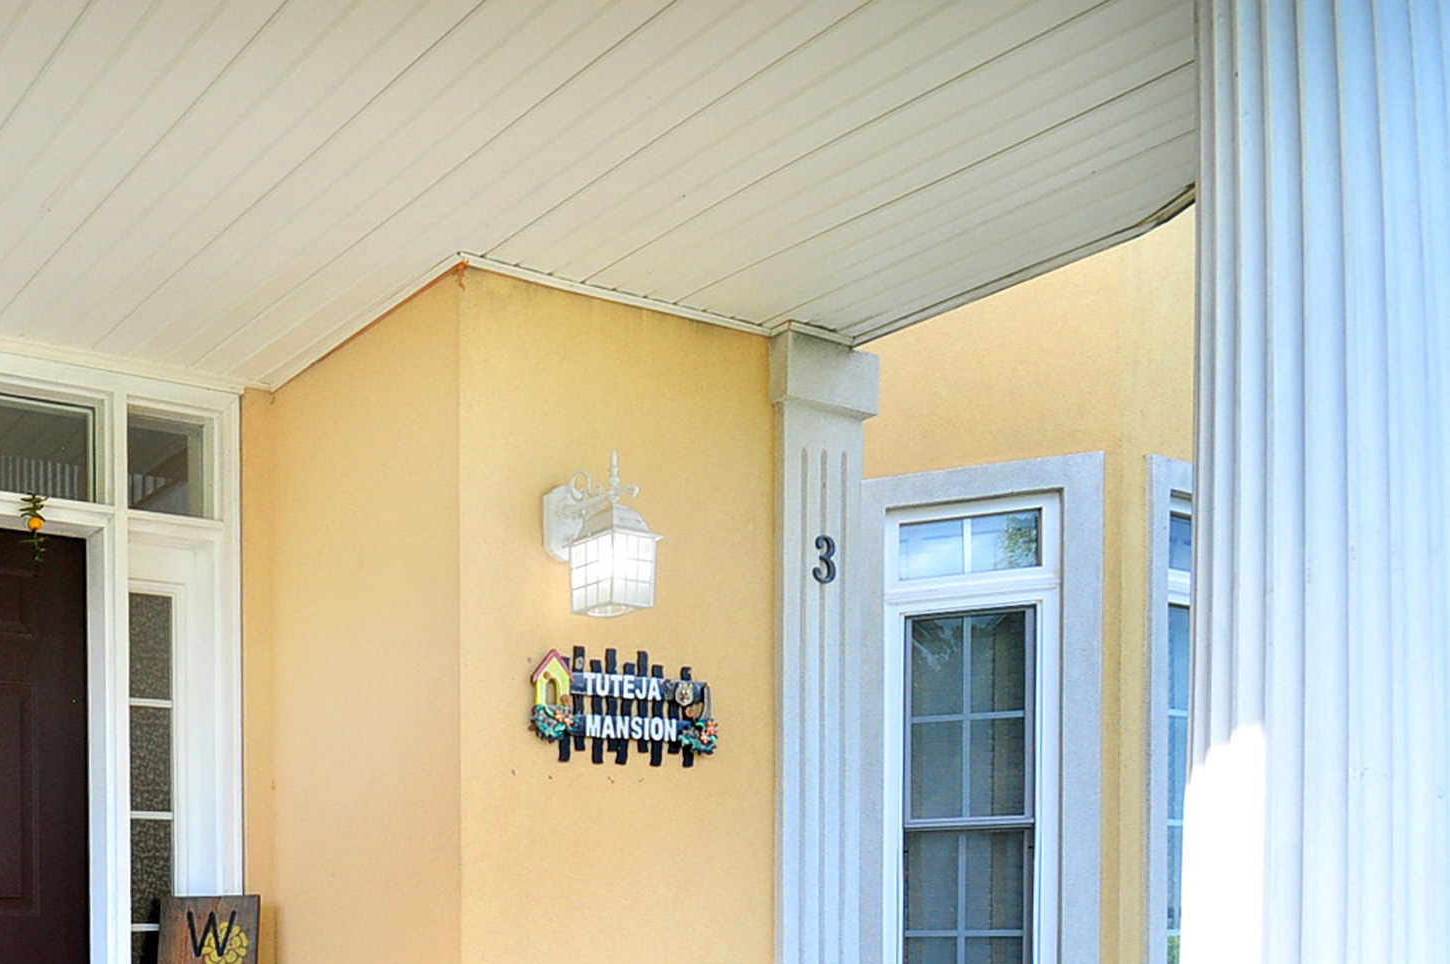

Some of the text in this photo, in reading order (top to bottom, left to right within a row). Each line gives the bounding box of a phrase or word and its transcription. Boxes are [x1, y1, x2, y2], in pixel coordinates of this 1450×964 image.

[812, 534, 837, 584] 3
[583, 671, 662, 701] TUTEJA
[585, 714, 678, 743] MANSION
